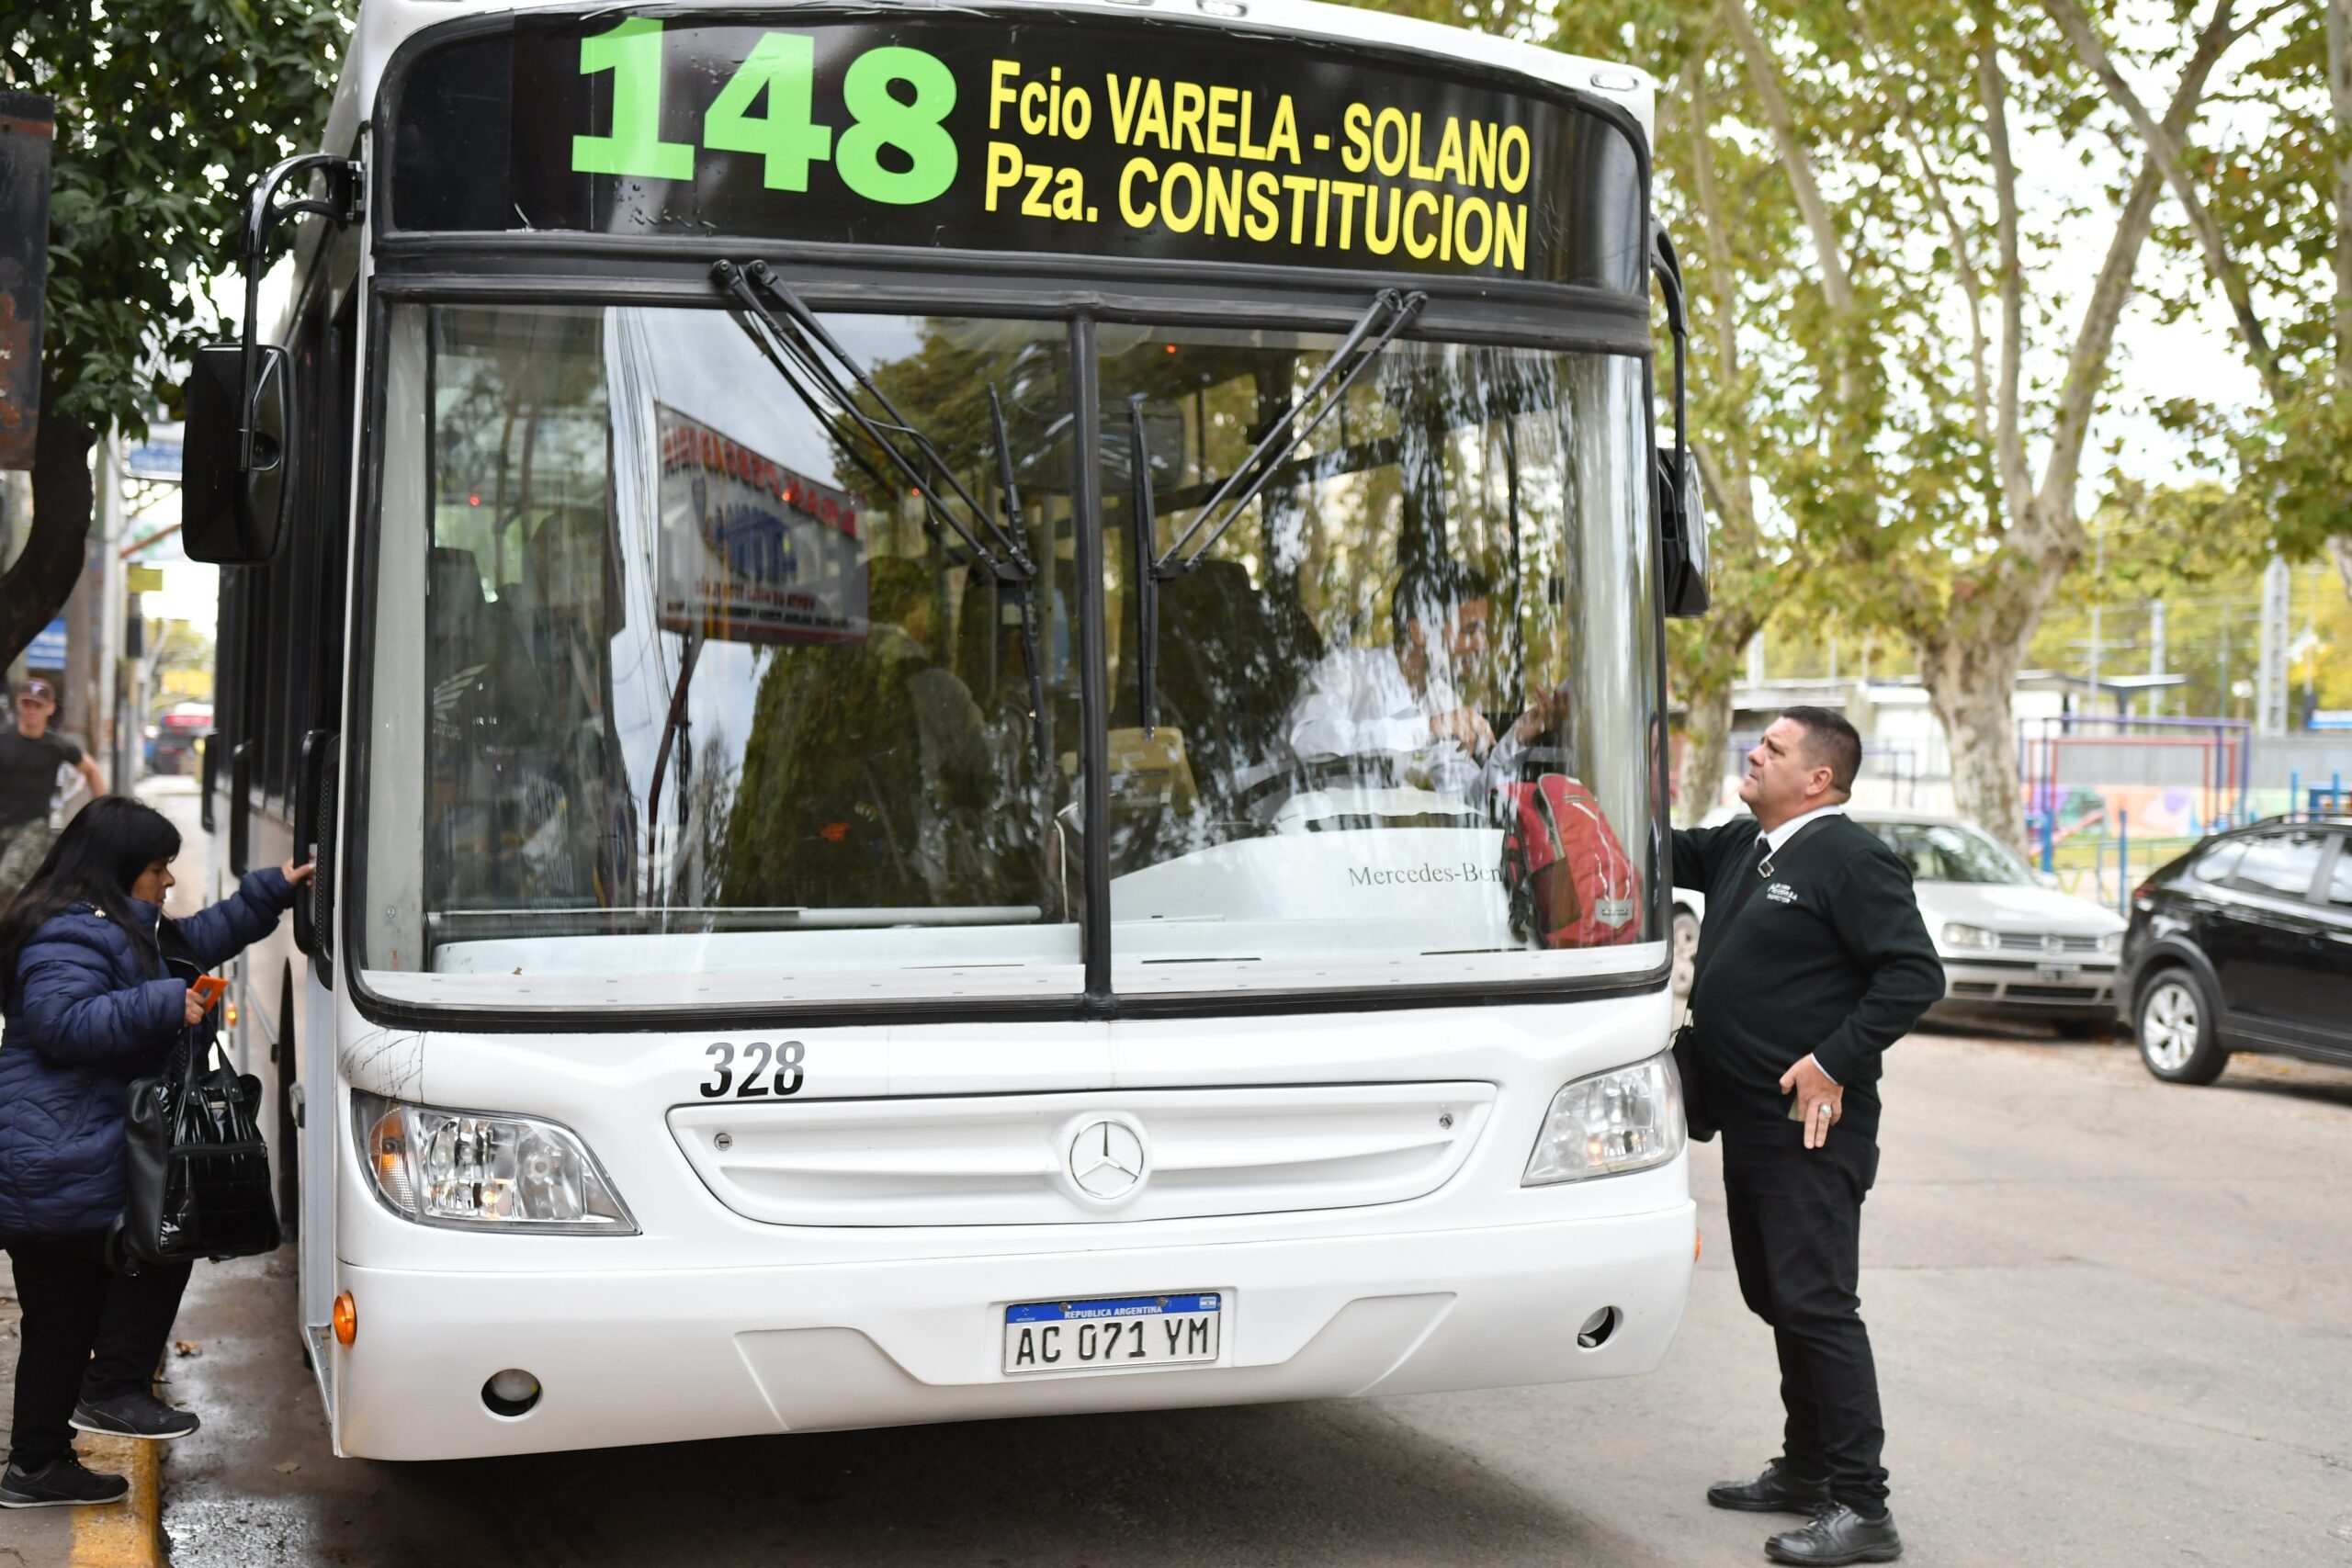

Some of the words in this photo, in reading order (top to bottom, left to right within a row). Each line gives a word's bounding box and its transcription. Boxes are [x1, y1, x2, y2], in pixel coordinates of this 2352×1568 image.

[571, 16, 959, 205] 148
[985, 59, 1093, 141] Fcio
[1106, 73, 1302, 164] VARELA
[1340, 102, 1532, 194] SOLANO
[985, 141, 1099, 222] Pza.
[1118, 157, 1528, 271] CONSTITUCION
[1348, 863, 1503, 887] Mercedes-Ben
[700, 1040, 806, 1099] 328
[1016, 1325, 1060, 1365] AC
[1079, 1321, 1147, 1361] 071
[1164, 1317, 1209, 1356] YM
[1064, 1310, 1112, 1319] REPUBLICA
[1114, 1305, 1162, 1317] ARGENTINA
